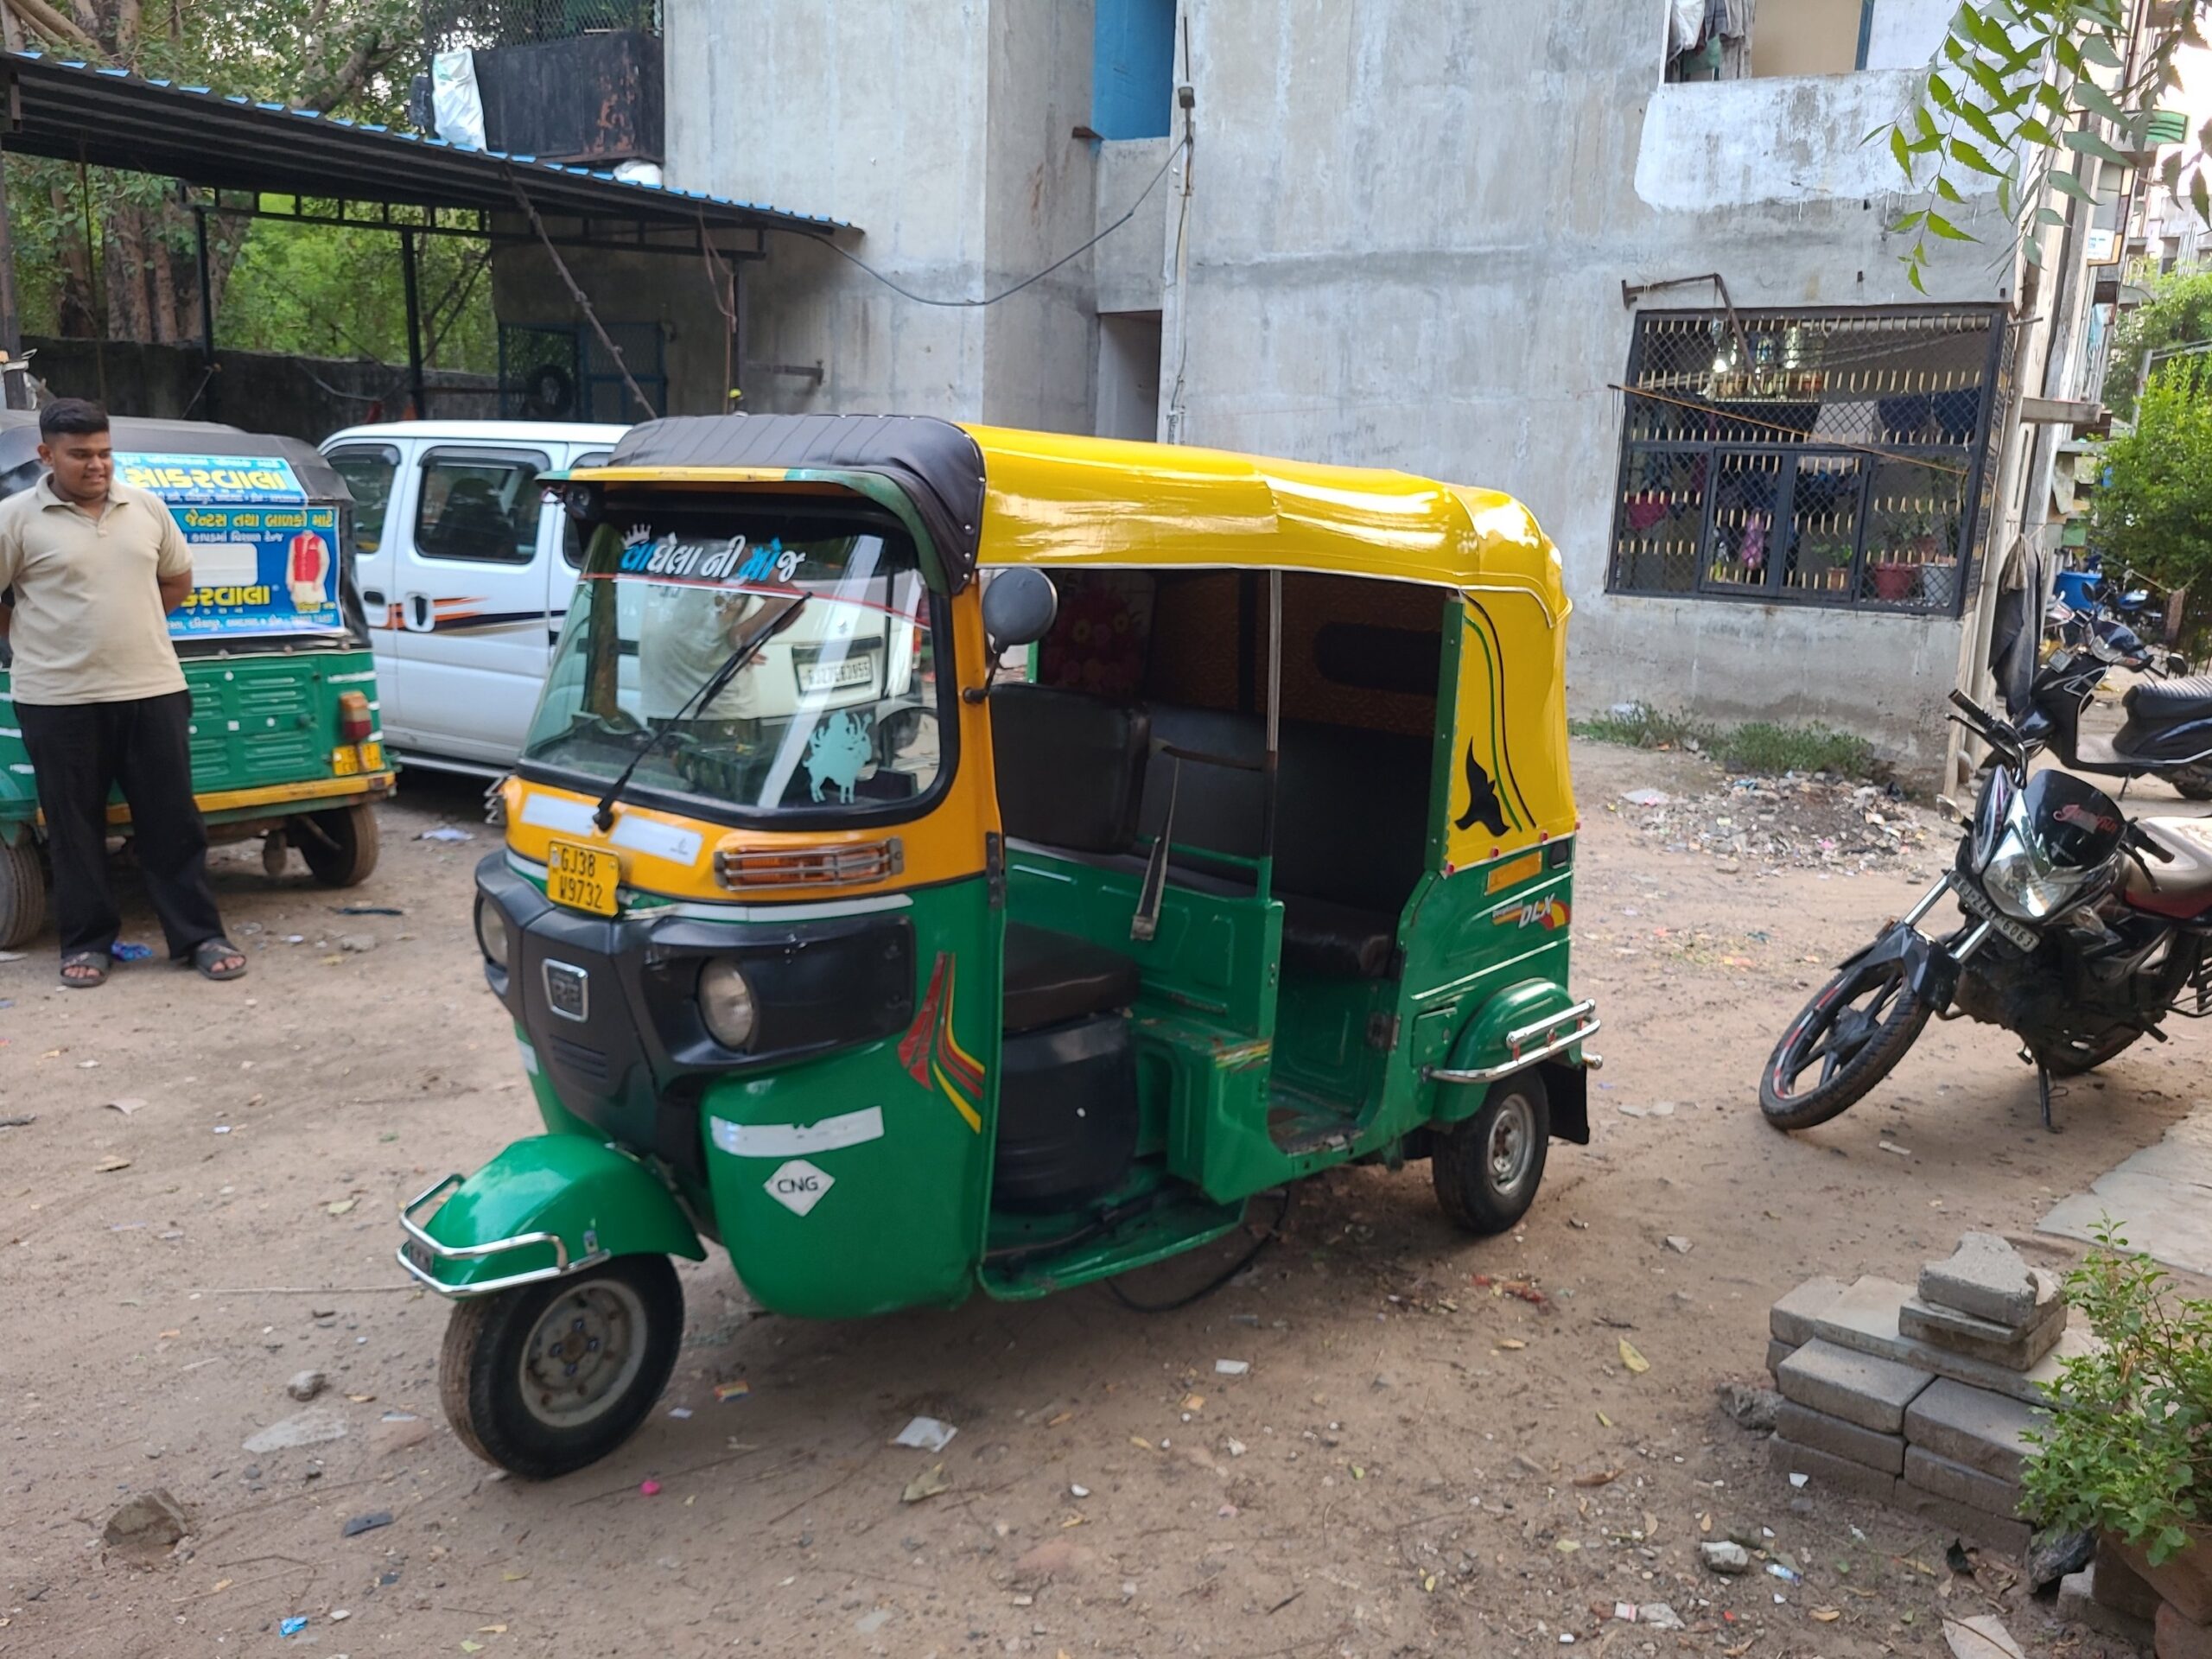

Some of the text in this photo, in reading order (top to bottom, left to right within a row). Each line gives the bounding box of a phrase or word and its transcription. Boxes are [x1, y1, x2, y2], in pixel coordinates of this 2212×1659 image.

[561, 847, 596, 878] GJ38
[559, 874, 603, 909] W9732
[1518, 893, 1555, 929] DLX
[777, 1176, 819, 1194] CNG
